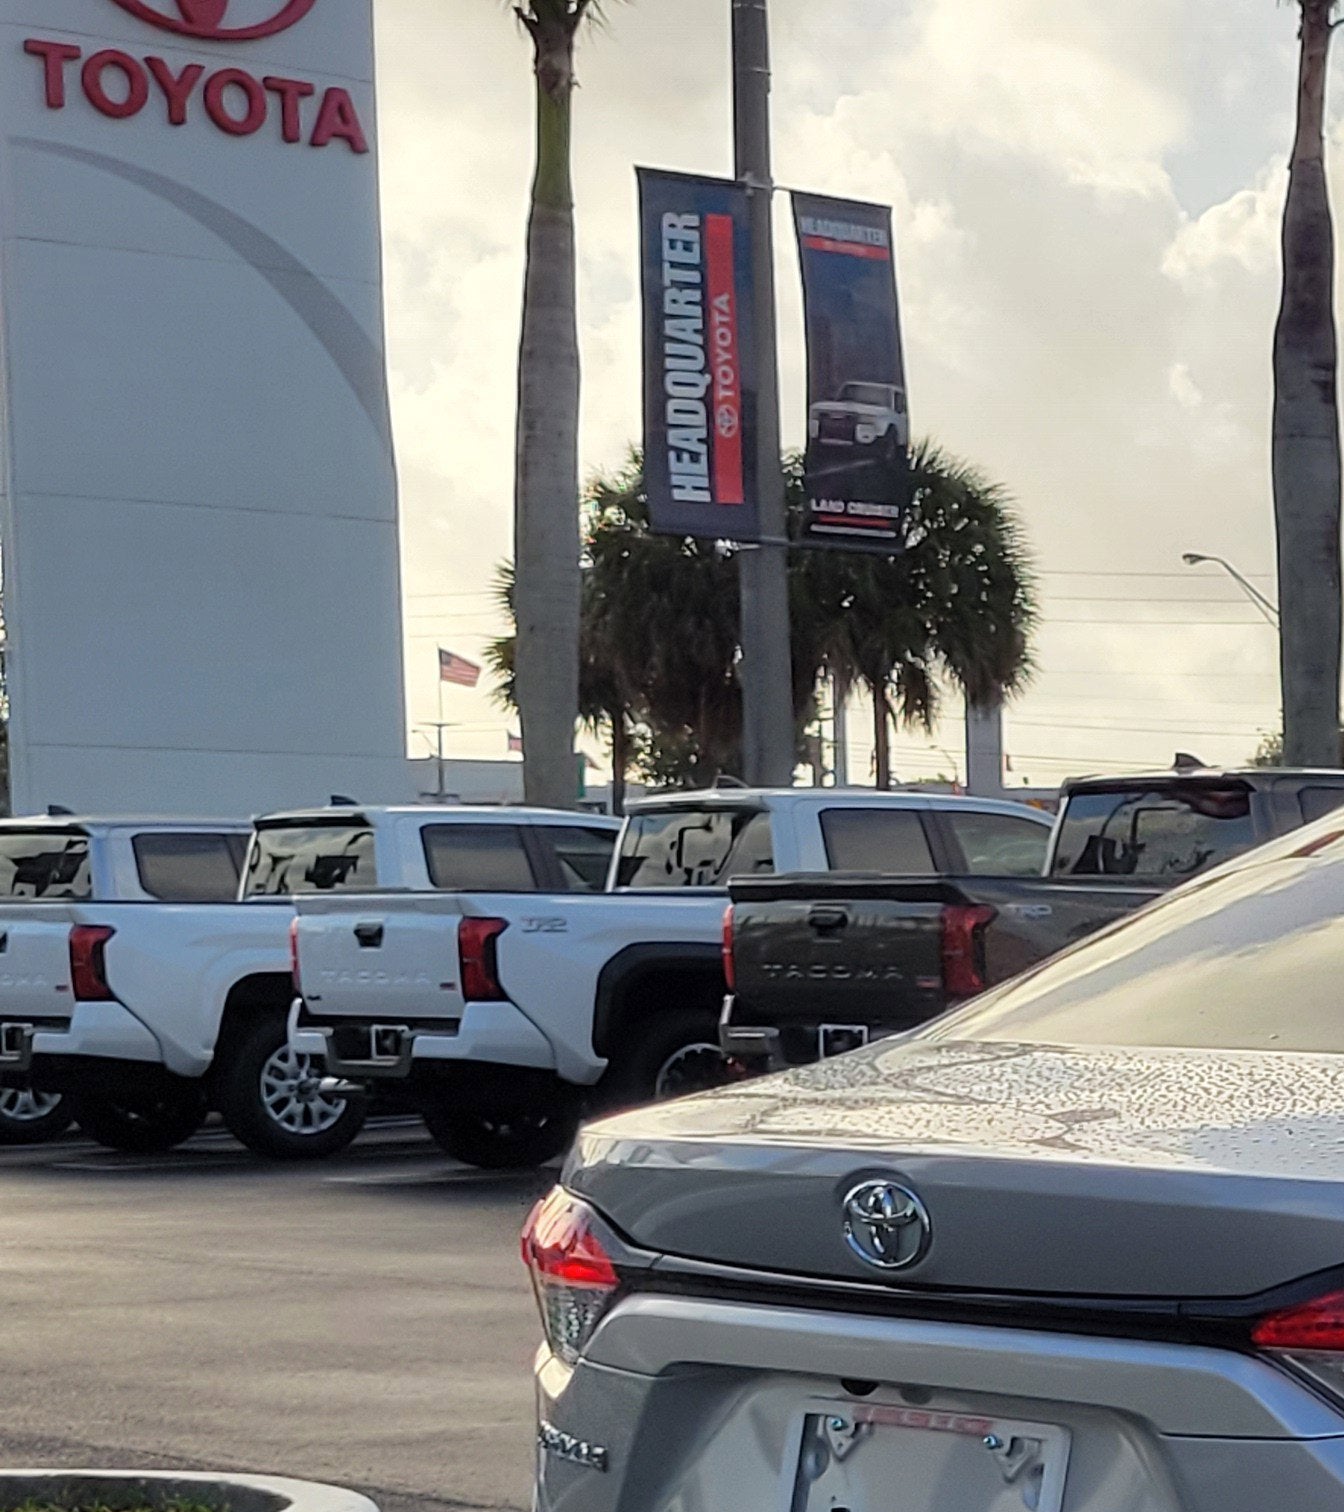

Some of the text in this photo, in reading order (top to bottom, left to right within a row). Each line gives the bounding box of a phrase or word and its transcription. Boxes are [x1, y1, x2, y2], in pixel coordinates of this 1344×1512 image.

[24, 39, 369, 154] TOYOTA
[661, 211, 712, 503] HEADQUARTER
[712, 292, 736, 399] TOYOTA
